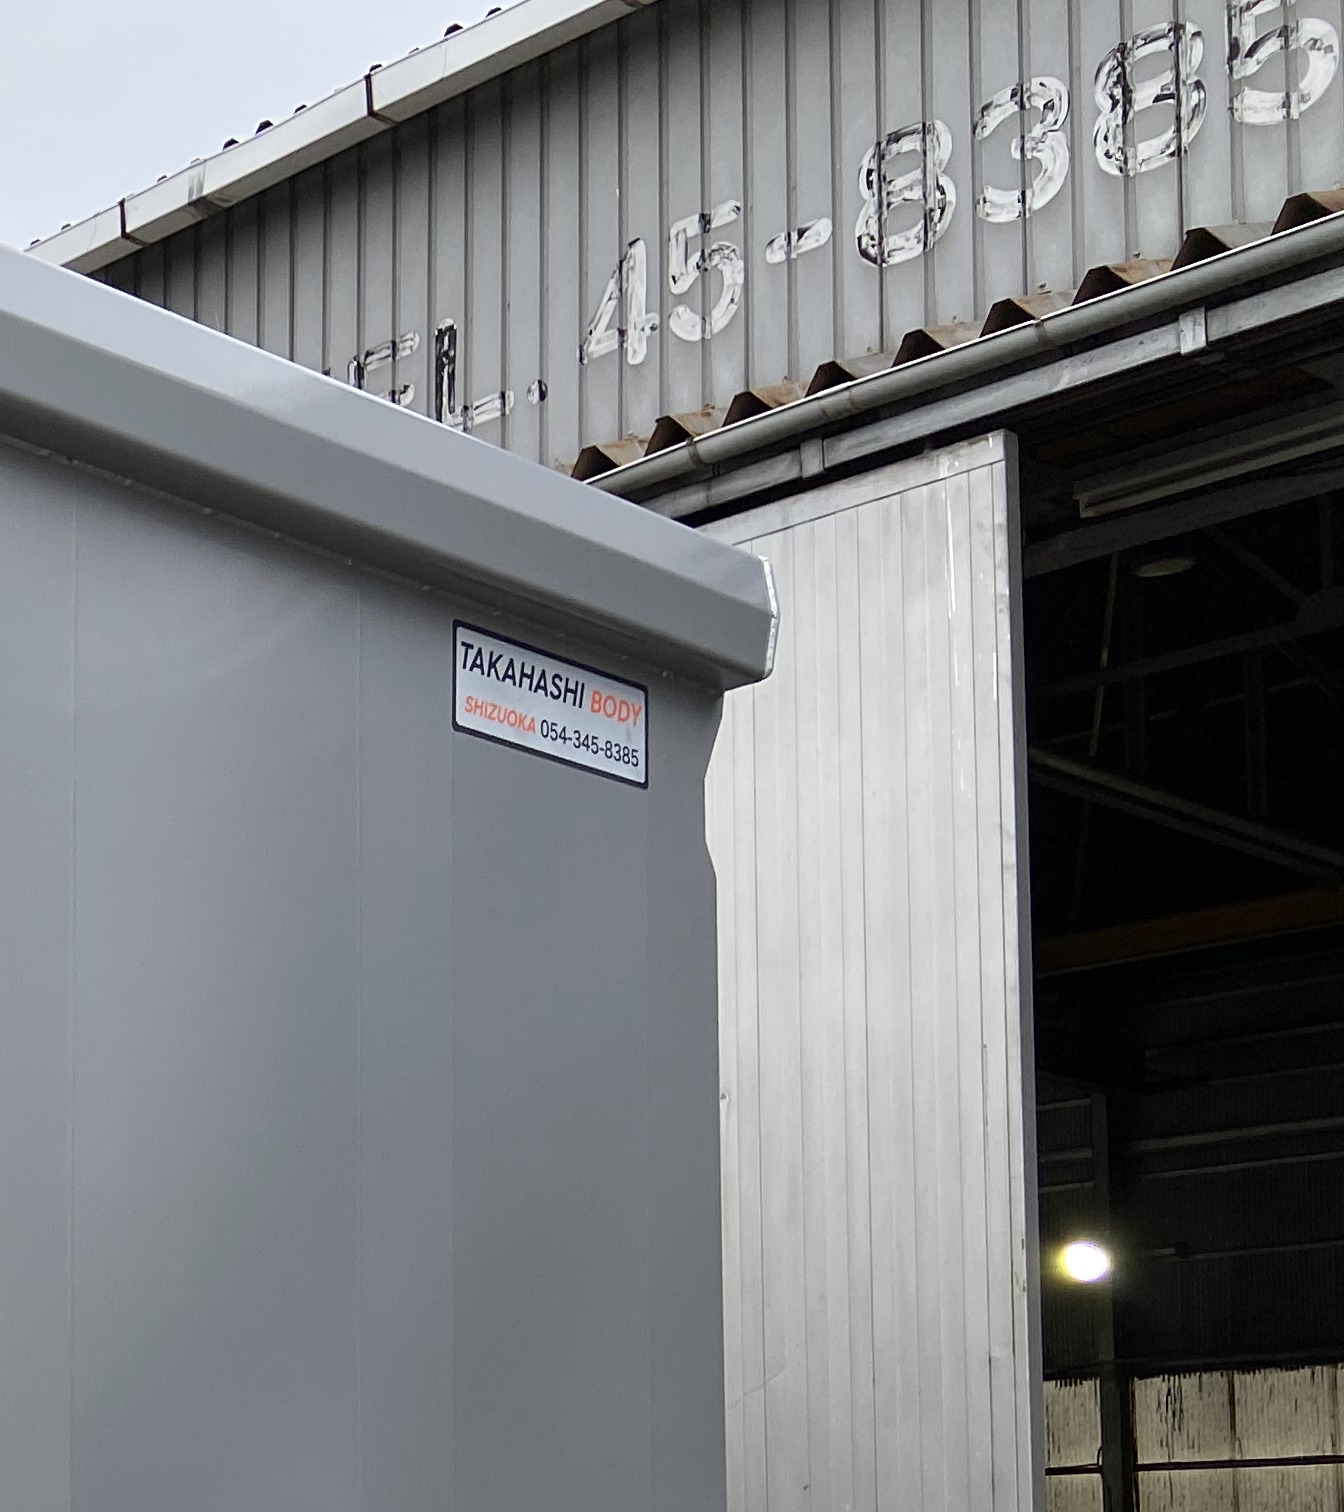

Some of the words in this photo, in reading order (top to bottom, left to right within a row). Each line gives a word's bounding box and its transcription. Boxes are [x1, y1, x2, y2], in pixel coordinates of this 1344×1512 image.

[461, 641, 585, 709] TAKAHASHI
[589, 689, 642, 727] BODY
[464, 695, 536, 734] SHIZUOKA
[540, 719, 639, 767] 054-345-8385
